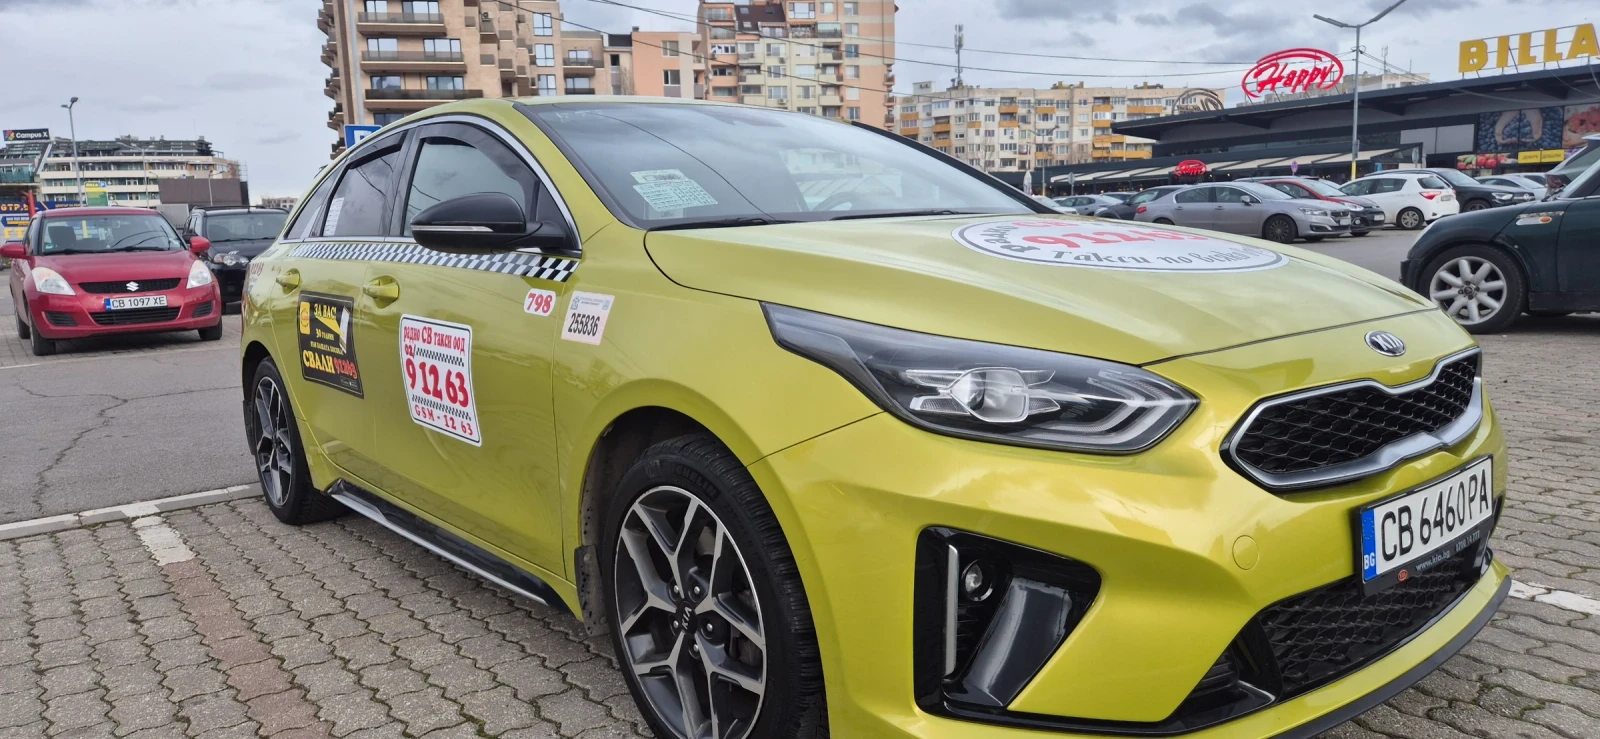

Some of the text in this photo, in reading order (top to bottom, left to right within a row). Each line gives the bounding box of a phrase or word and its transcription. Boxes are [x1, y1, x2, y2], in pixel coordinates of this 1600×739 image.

[1458, 23, 1599, 73] BILLA
[1253, 62, 1335, 94] Happy
[112, 299, 125, 308] CB
[128, 297, 150, 306] 1097
[153, 296, 165, 305] XE
[314, 303, 322, 317] ЗА
[323, 305, 337, 320] ВАС!
[526, 292, 553, 314] 798
[404, 326, 420, 344] радио
[422, 326, 432, 345] СВ
[567, 312, 600, 337] 255836
[302, 349, 335, 374] СВАЛИ
[414, 404, 435, 422] GSM
[1381, 504, 1414, 562] CB
[1419, 480, 1466, 546] 6460
[1363, 552, 1376, 570] BG
[1416, 550, 1451, 571] www.kia.bg
[681, 606, 693, 630] KIA
